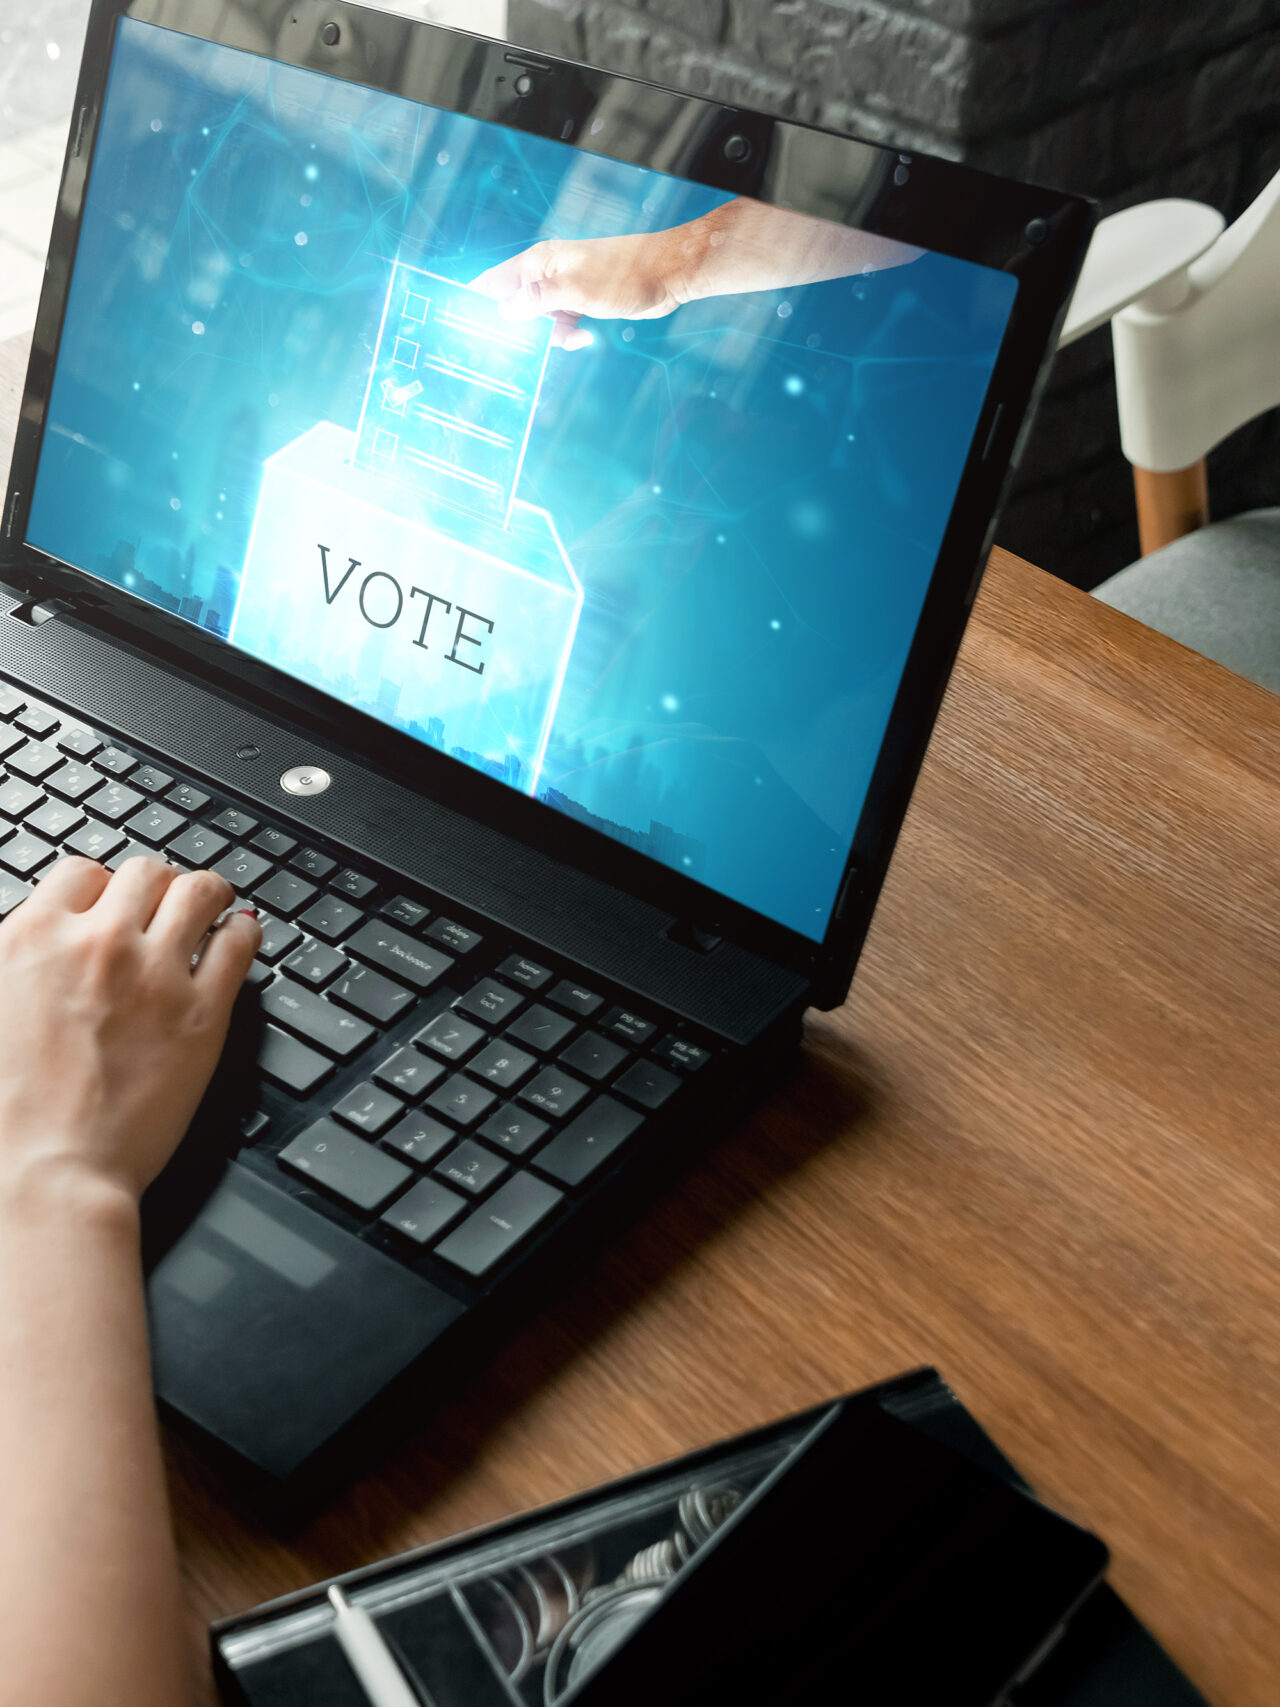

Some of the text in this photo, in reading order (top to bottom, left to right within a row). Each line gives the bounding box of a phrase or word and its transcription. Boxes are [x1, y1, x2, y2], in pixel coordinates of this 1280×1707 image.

[317, 543, 495, 675] VOTE
[495, 1058, 509, 1068] 8
[551, 1087, 562, 1097] 9
[508, 1125, 520, 1134] 6
[414, 1131, 426, 1140] 2
[467, 1161, 479, 1172] 3
